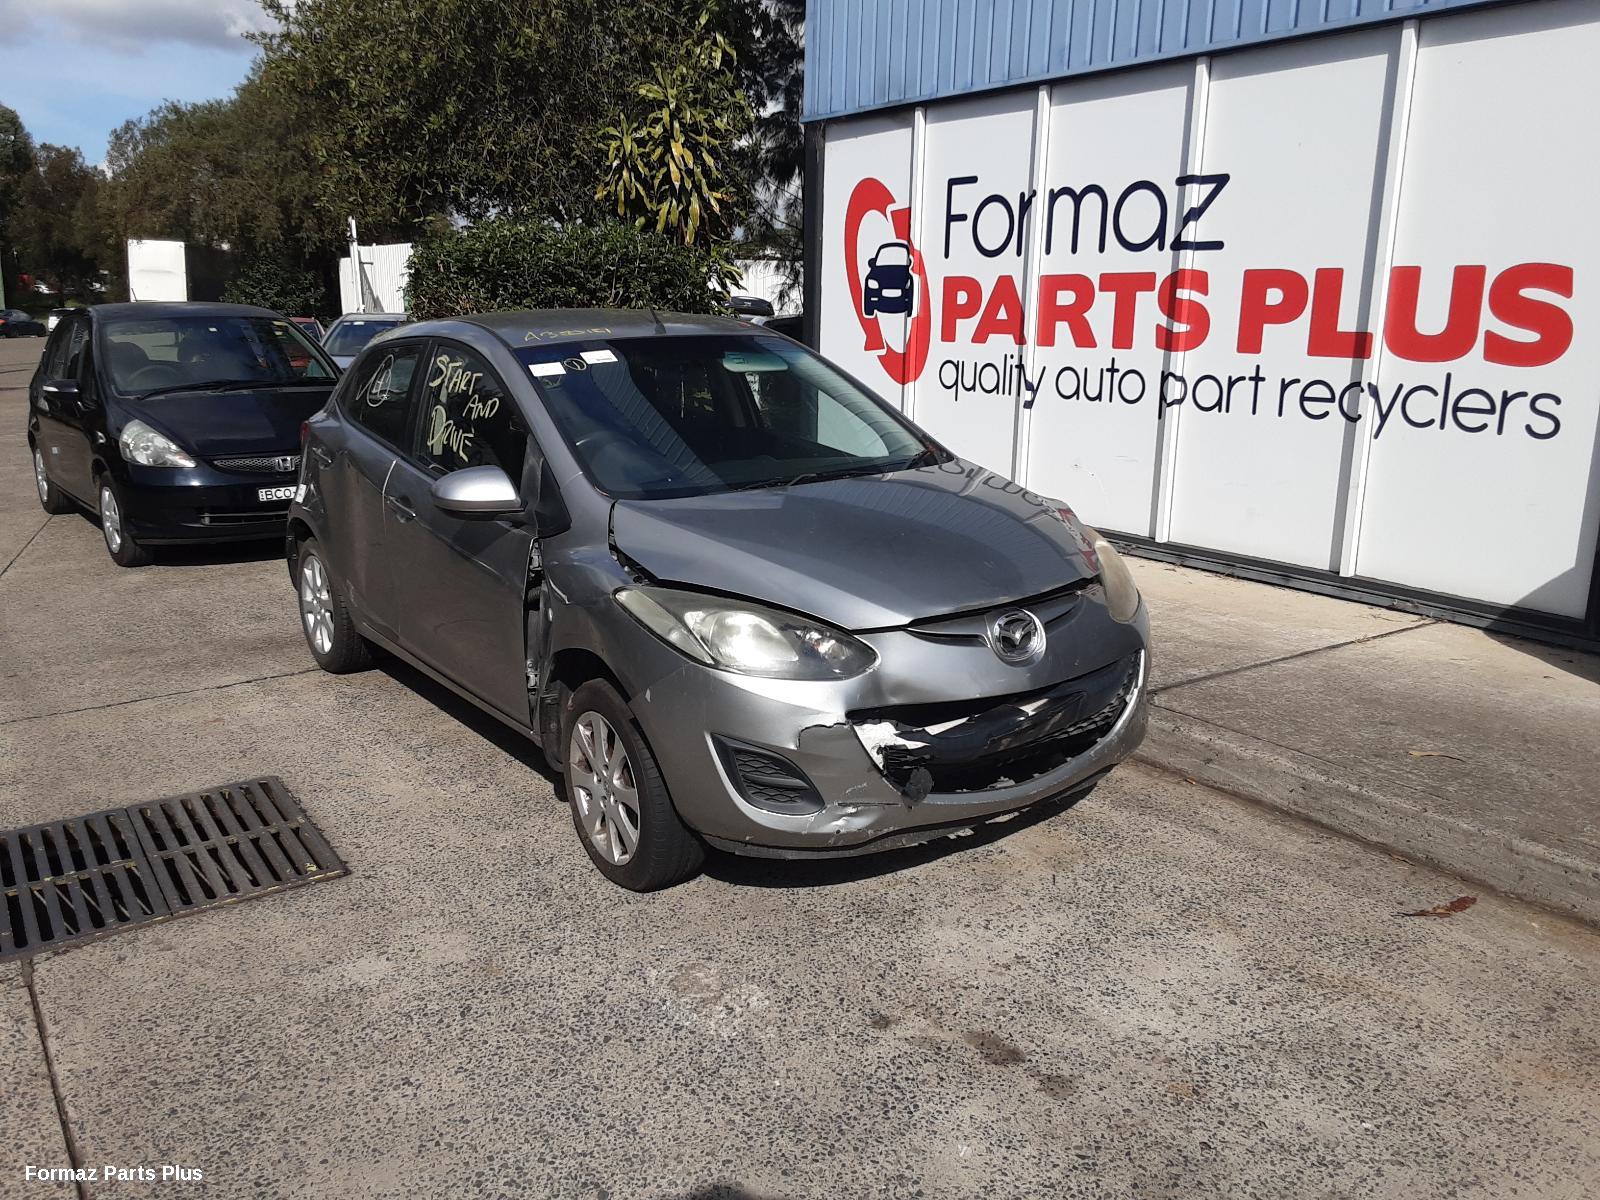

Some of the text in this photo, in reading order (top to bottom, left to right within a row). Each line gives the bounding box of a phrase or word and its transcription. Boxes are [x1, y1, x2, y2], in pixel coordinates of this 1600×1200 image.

[945, 174, 1230, 258] Formaz
[940, 263, 1574, 367] PARTS PLUS
[429, 355, 483, 396] START
[463, 394, 499, 420] AND
[938, 354, 1562, 440] quality auto part recyclers
